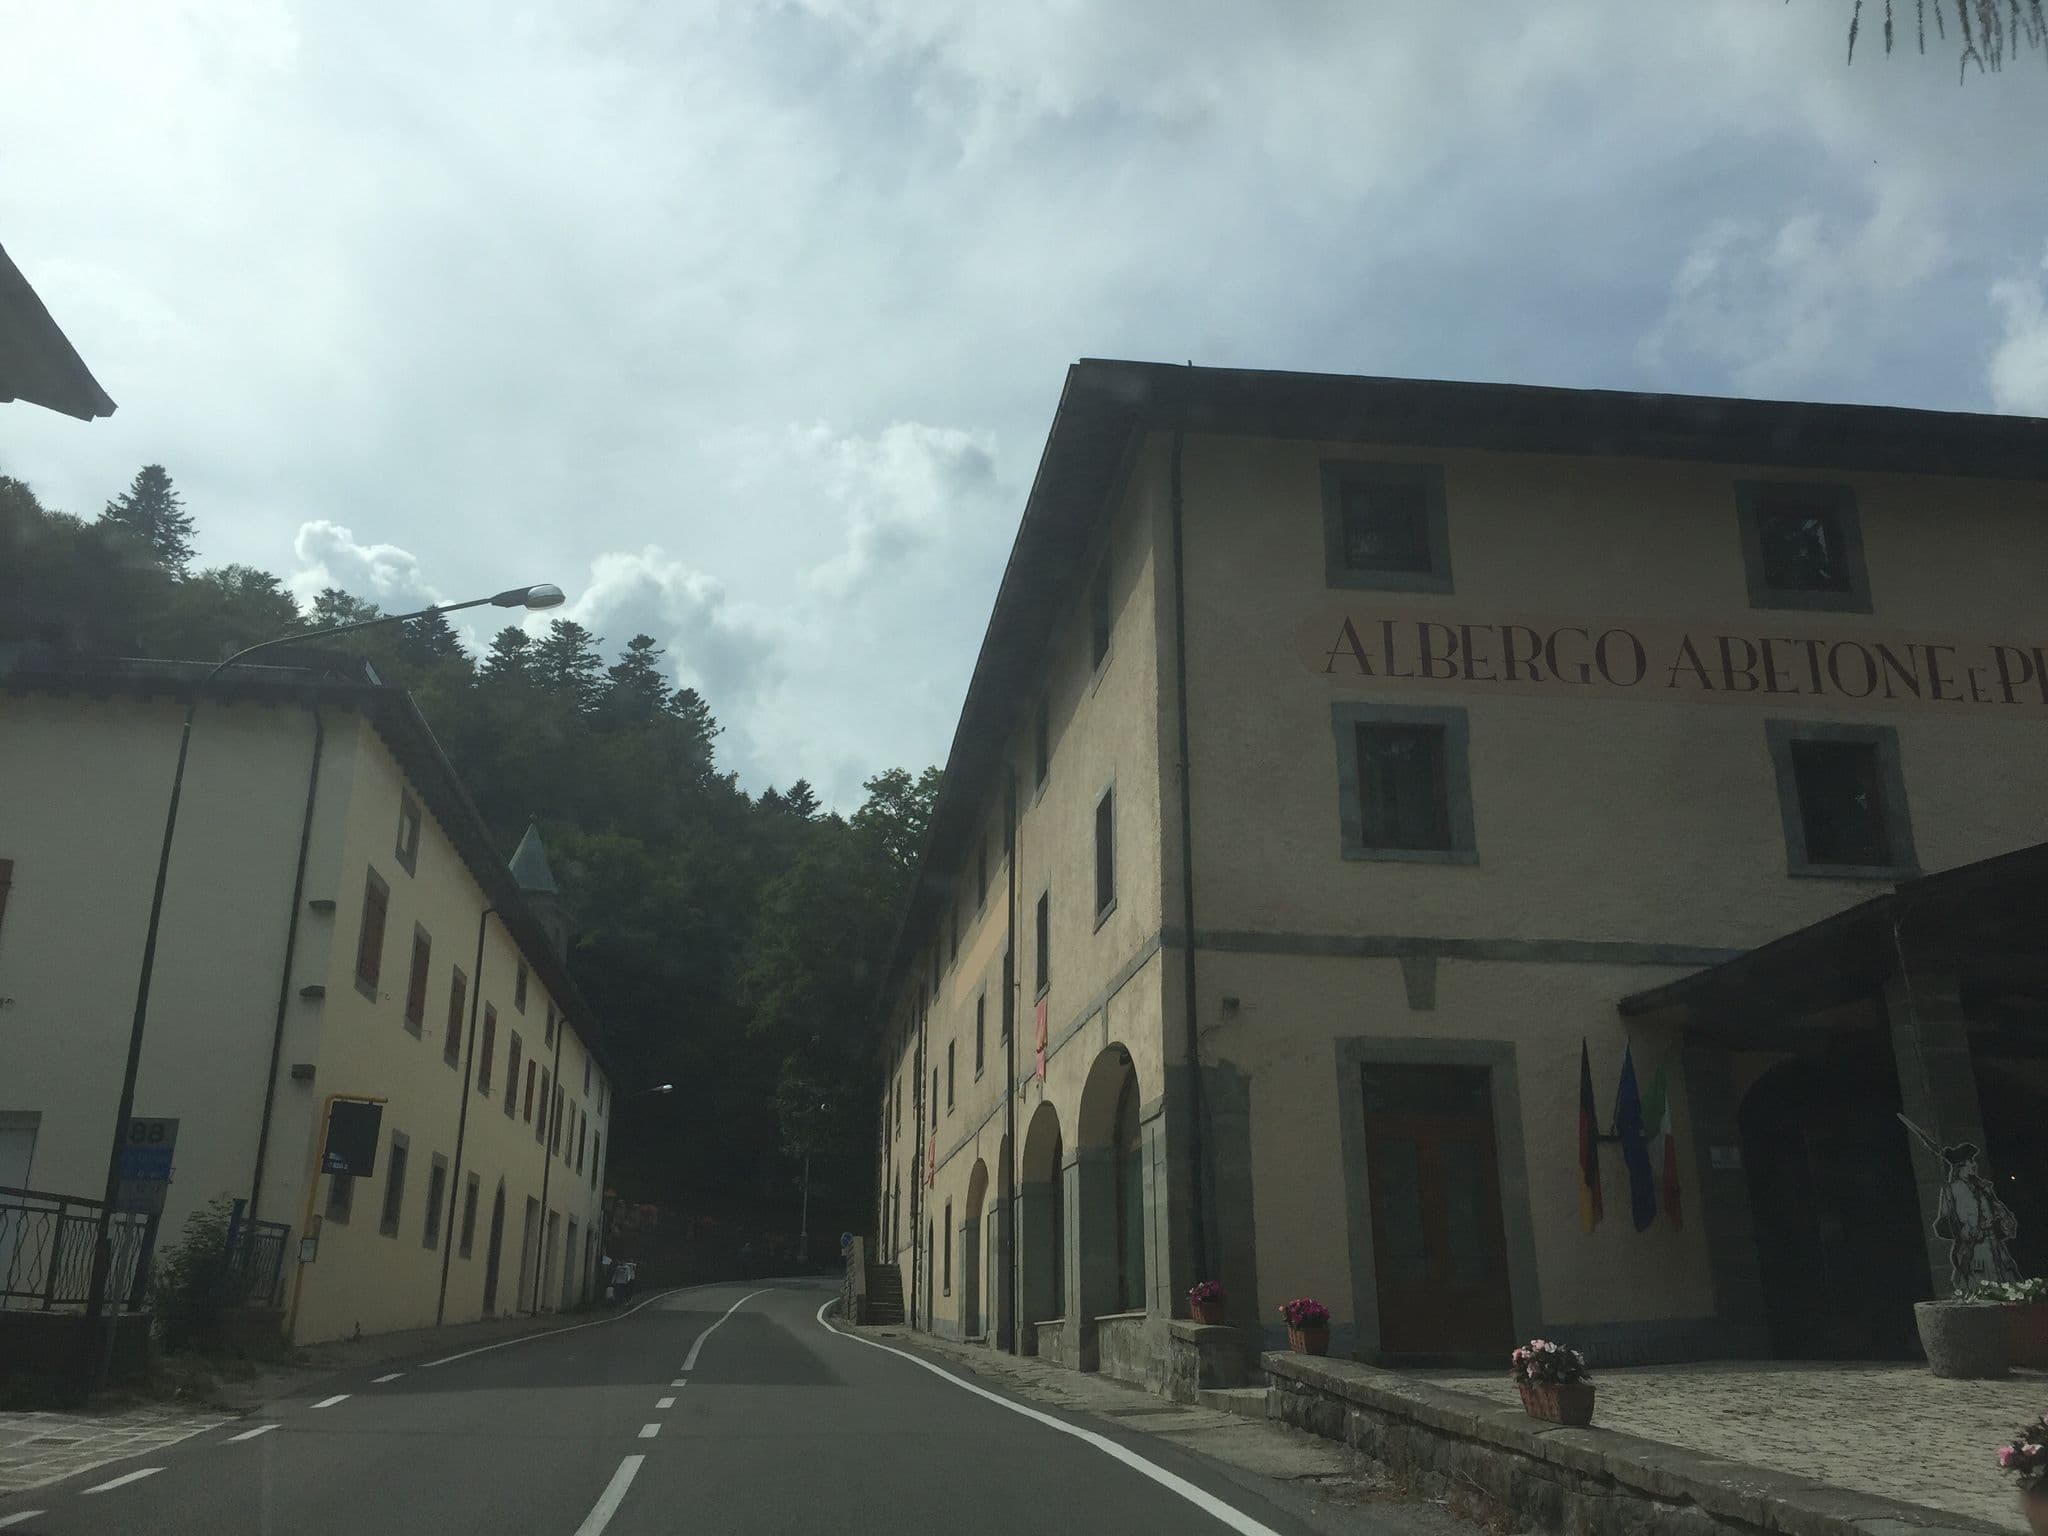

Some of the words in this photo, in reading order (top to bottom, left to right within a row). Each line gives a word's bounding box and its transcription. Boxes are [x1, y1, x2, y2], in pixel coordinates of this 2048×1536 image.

[1322, 615, 1646, 686] ALBERGO
[1666, 634, 1964, 702] ABETONE
[1967, 669, 1993, 704] E
